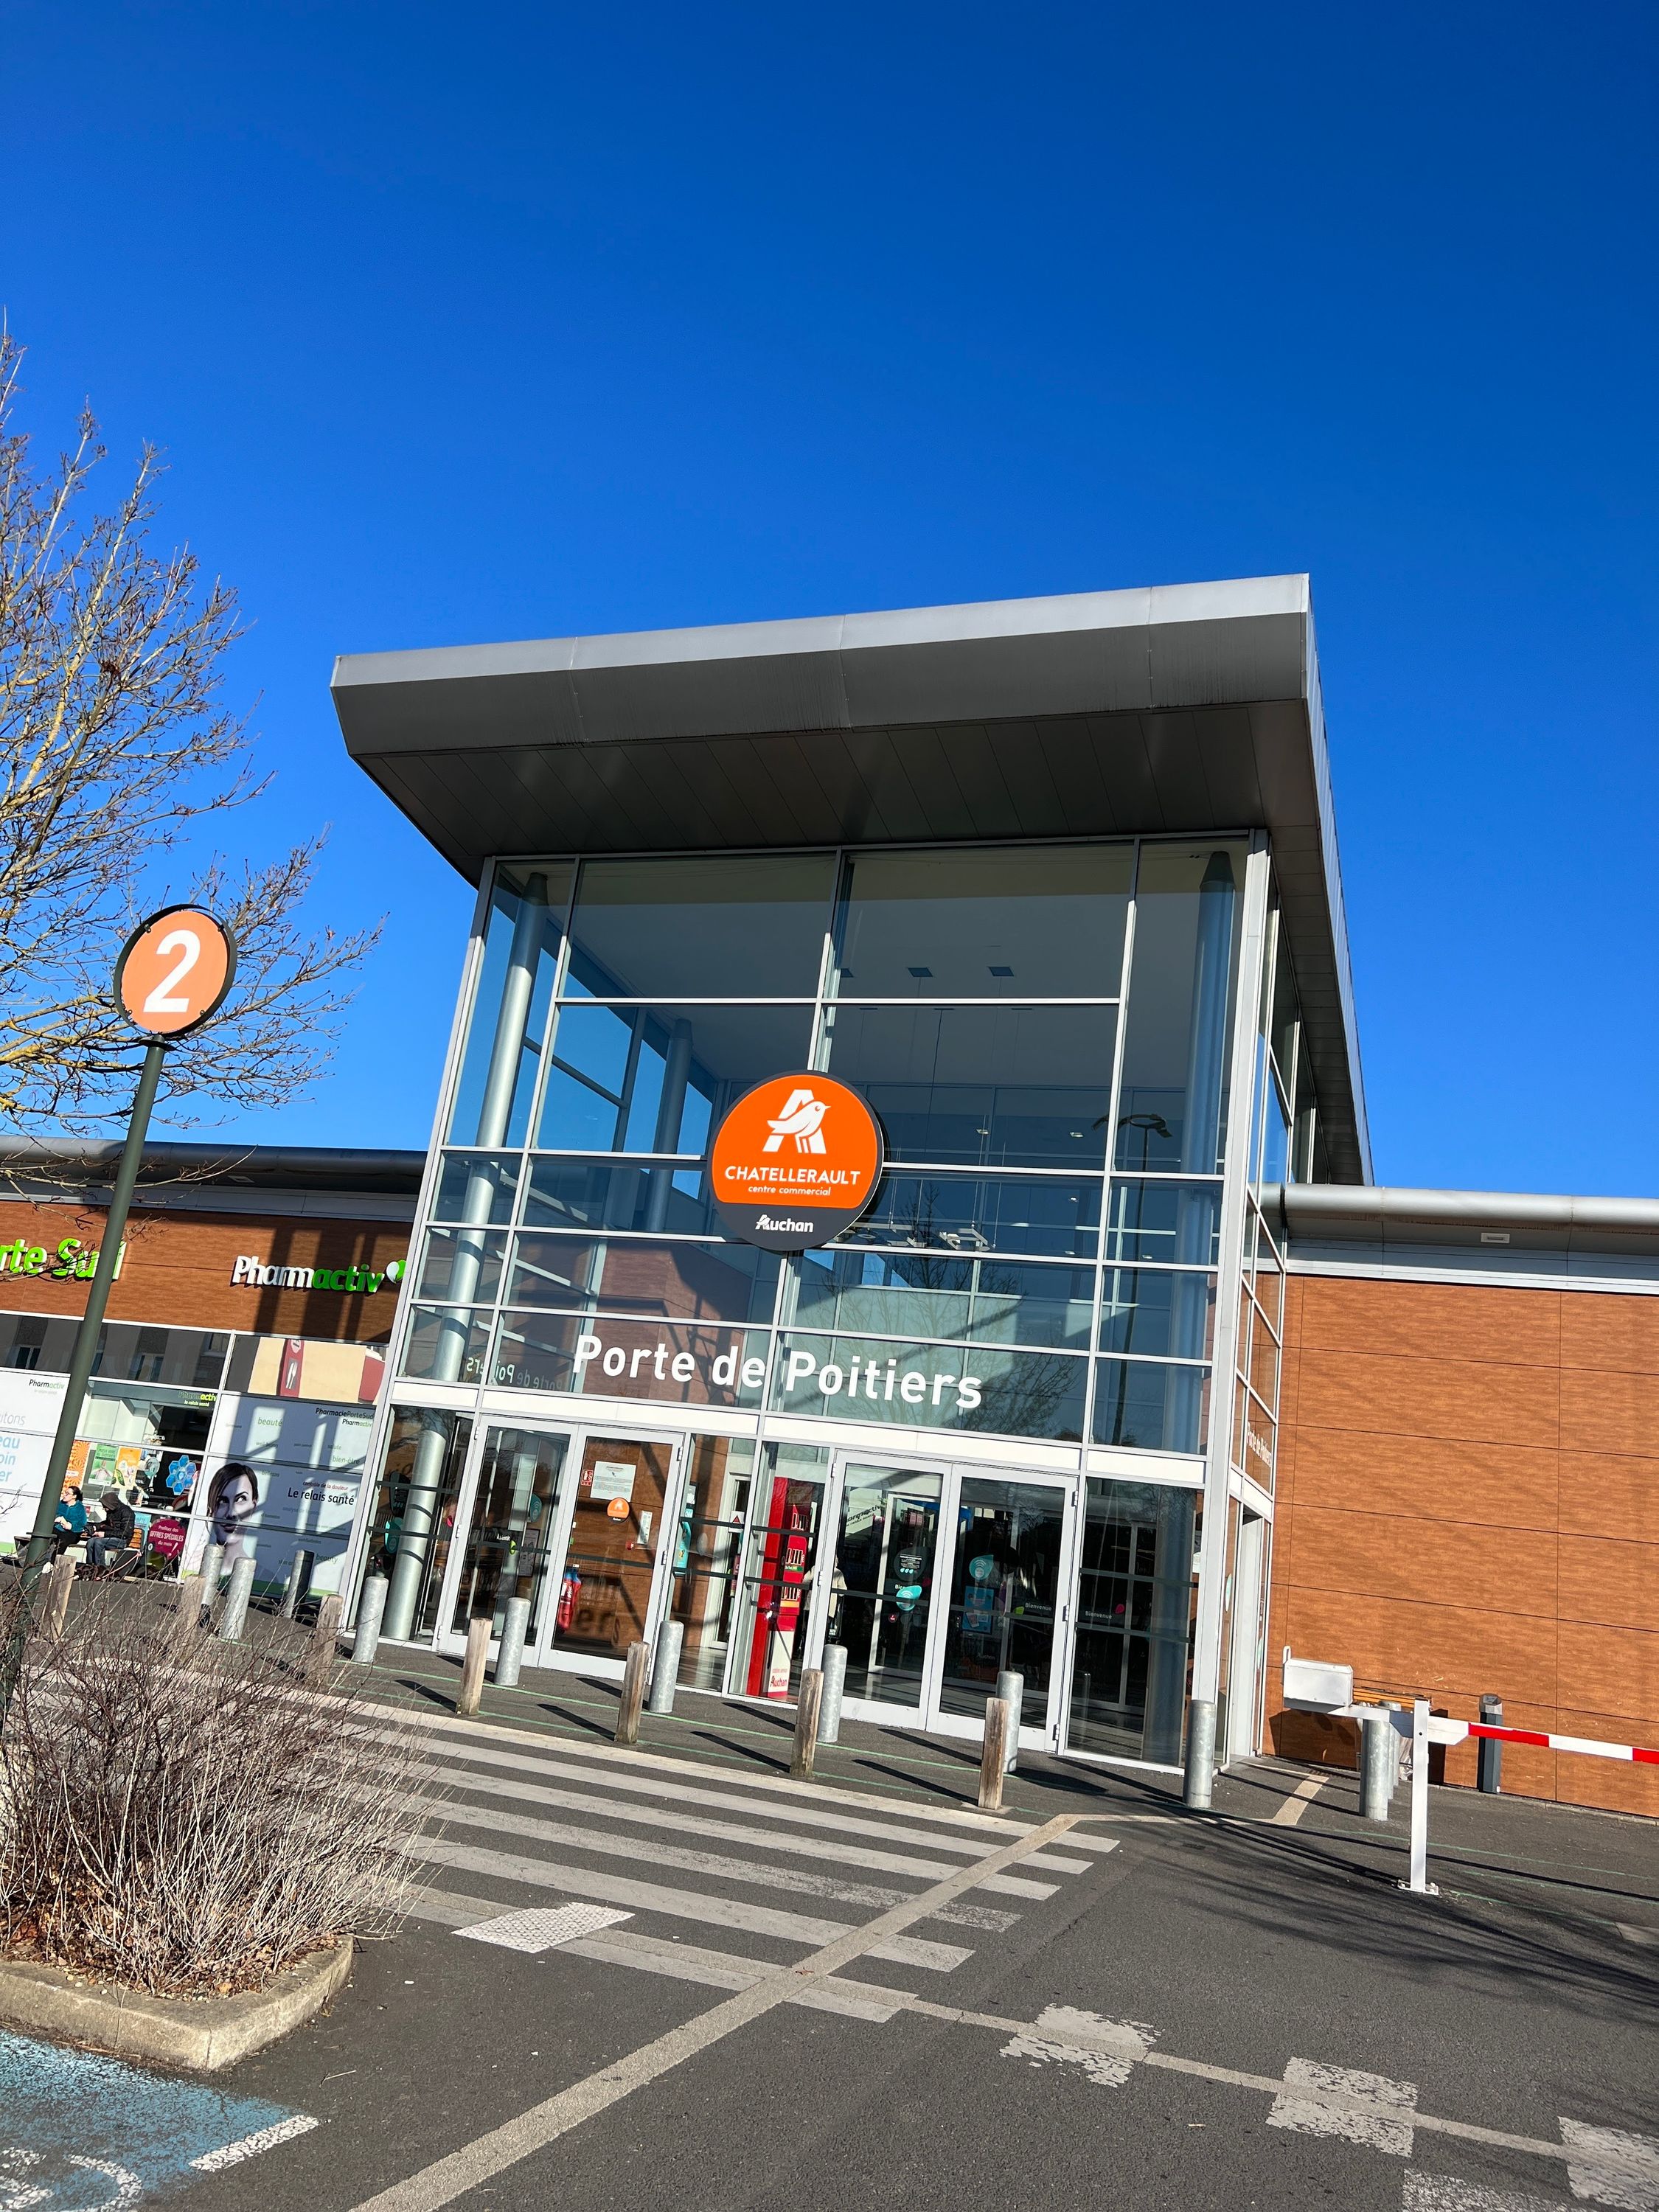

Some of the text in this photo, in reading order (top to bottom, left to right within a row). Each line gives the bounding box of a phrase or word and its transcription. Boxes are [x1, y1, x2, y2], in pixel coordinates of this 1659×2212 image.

[143, 929, 201, 1012] 2
[725, 1165, 860, 1185] CHATELLERAULT
[748, 1185, 831, 1196] centre commercial
[755, 1214, 814, 1233] Auchan
[52, 1237, 127, 1280] Su
[232, 1255, 385, 1293] Pharmactiv
[573, 1335, 982, 1409] Porte de Poitiers
[29, 1379, 65, 1389] Pharmactiv
[257, 1416, 283, 1427] beauté
[288, 1487, 355, 1506] Le relais santé
[150, 1530, 164, 1539] OFFRES
[1025, 1601, 1052, 1611] Bienvenue
[1085, 1610, 1112, 1620] Bienvenue
